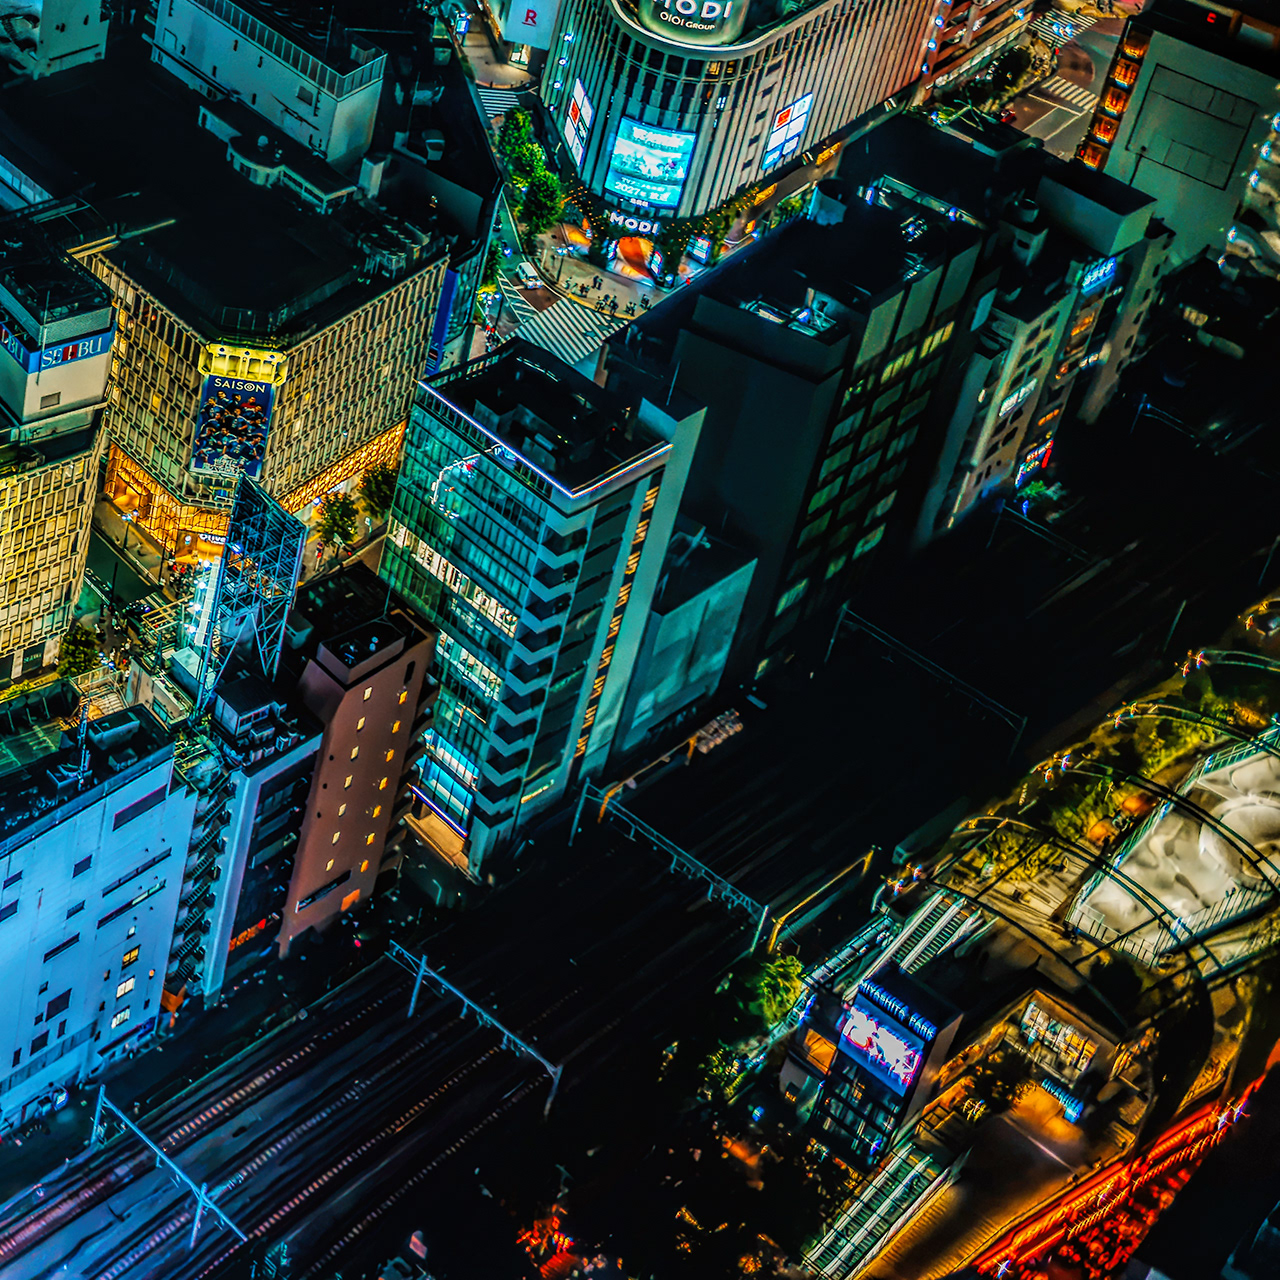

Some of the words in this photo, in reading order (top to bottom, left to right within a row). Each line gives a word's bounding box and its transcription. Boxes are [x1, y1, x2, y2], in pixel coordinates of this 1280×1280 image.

[686, 20, 716, 32] GROUP
[609, 210, 660, 236] MODI
[41, 337, 103, 368] SEIBU
[214, 376, 267, 394] SAISON
[907, 1010, 936, 1039] PARK
